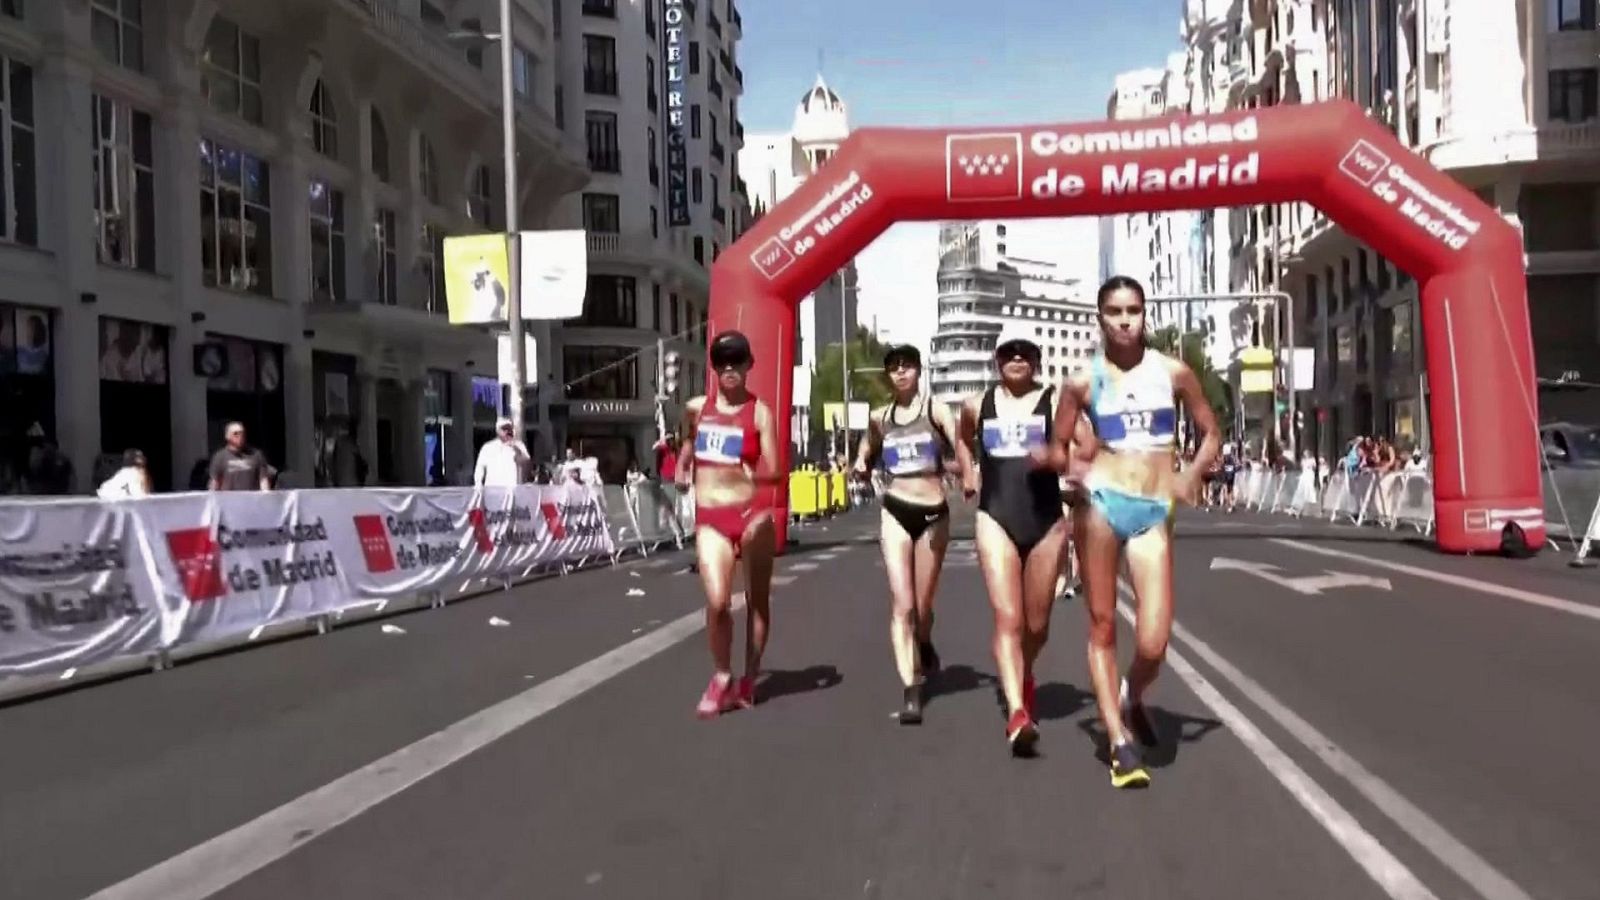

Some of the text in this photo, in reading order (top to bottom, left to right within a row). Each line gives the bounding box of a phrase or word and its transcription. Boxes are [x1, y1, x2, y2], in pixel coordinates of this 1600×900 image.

[669, 91, 686, 224] REGENTE
[1031, 117, 1258, 156] Comunidad
[1032, 152, 1259, 199] de Madrid
[779, 170, 860, 241] Comunidad
[794, 183, 873, 255] de Madrid
[1372, 181, 1469, 250] de Madrid
[1388, 164, 1481, 235] Comunidad
[216, 515, 328, 550] Comunidad
[386, 512, 455, 537] Comunidad
[228, 550, 338, 593] de Madrid
[396, 543, 417, 570] de
